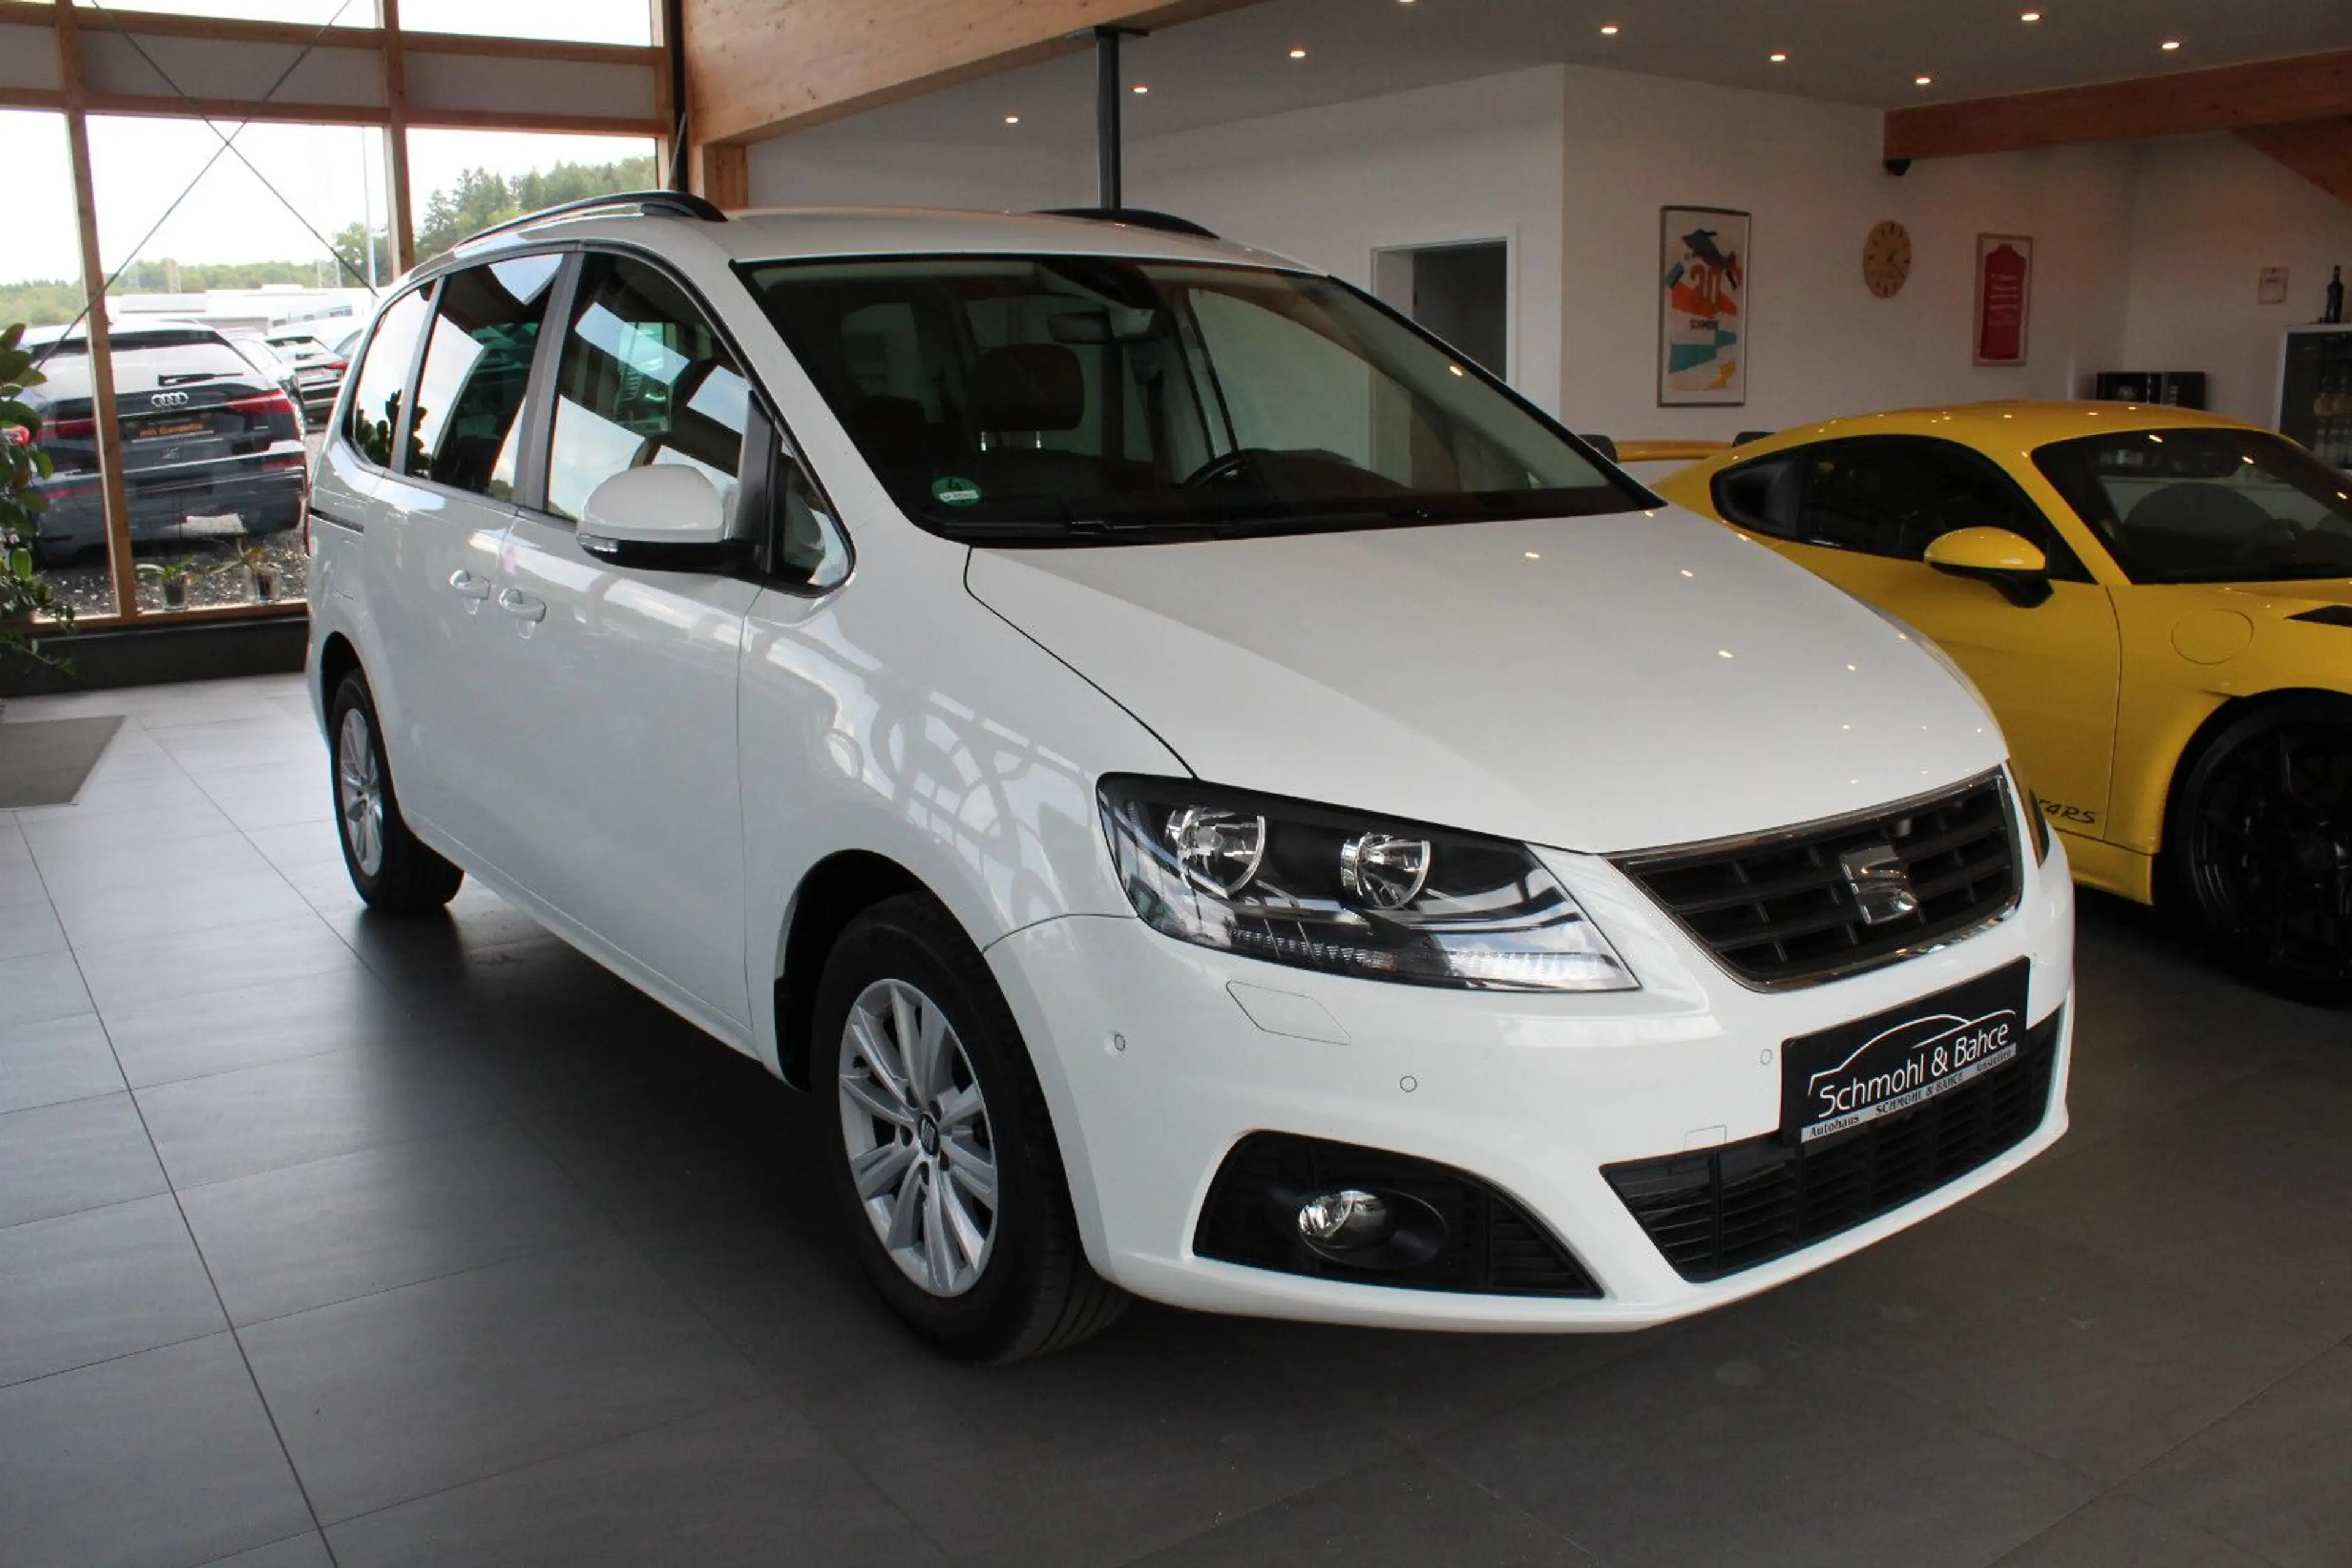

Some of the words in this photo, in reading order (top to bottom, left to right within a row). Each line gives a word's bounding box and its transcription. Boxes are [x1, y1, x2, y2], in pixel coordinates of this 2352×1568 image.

[1808, 1114, 1860, 1138] Autohaus
[1875, 1090, 1923, 1116] SCHMOHL
[1926, 1086, 1933, 1097] &
[1936, 1074, 1964, 1092] BAHCE
[1818, 1054, 1924, 1118] Schmohl
[1931, 1047, 1948, 1077] &
[1954, 1022, 2008, 1068] Bahce
